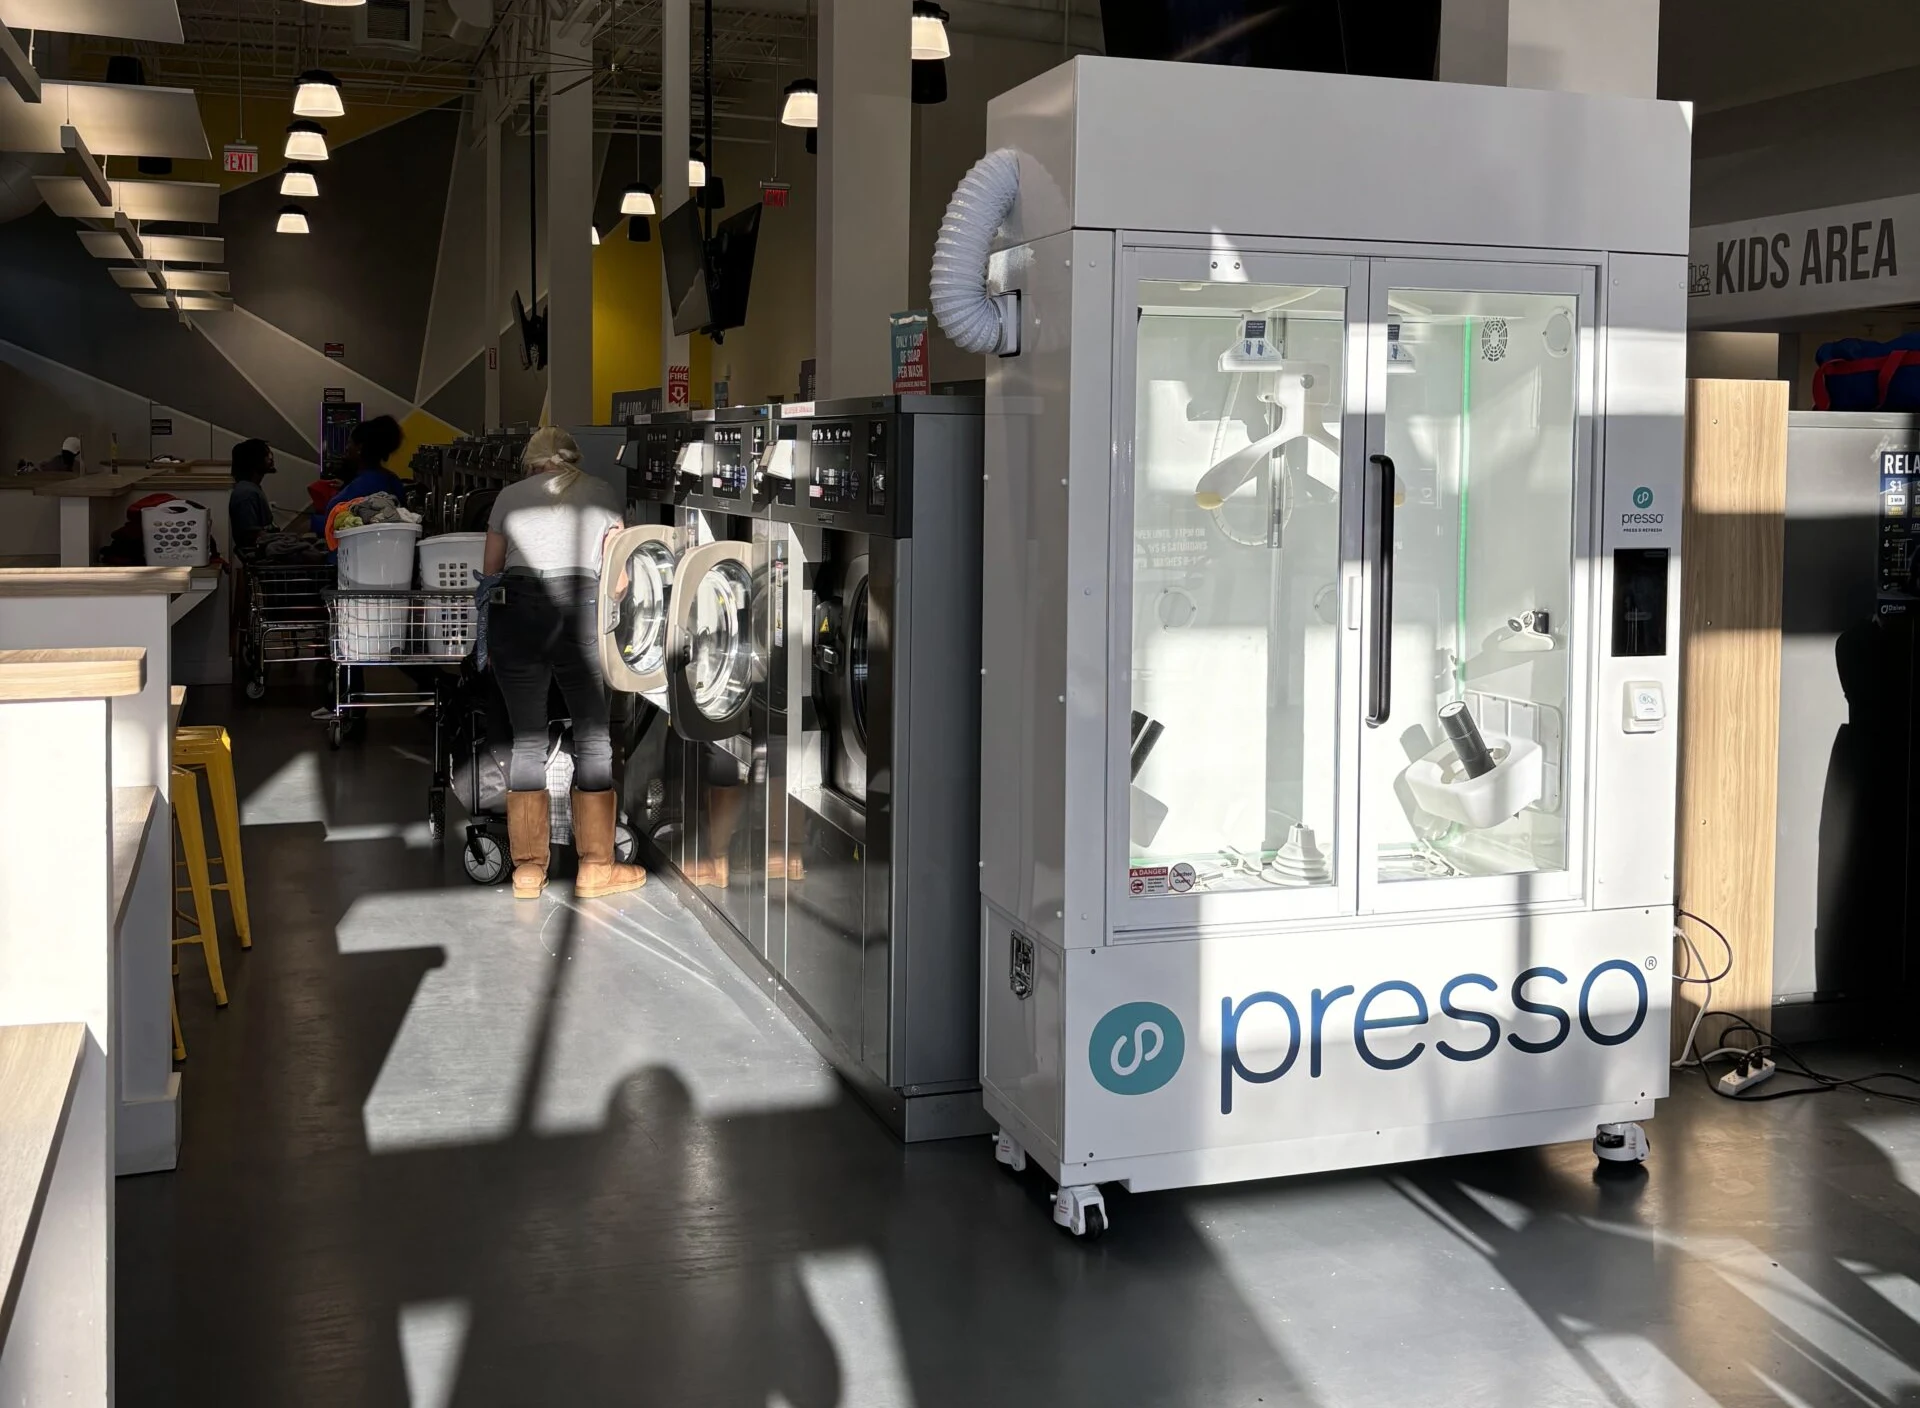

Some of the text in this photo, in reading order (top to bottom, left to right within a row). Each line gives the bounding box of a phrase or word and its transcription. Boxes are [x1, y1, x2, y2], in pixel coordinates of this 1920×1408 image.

[229, 153, 255, 171] EXIT
[1716, 218, 1897, 294] KIDS AREA
[896, 335, 907, 348] ONLY
[913, 333, 923, 346] CUP
[908, 349, 920, 362] SOAP
[669, 372, 688, 381] FIRE
[898, 364, 923, 378] PER WASH
[1884, 454, 1920, 474] RELA
[1889, 480, 1903, 493] $1
[1621, 513, 1663, 526] presso
